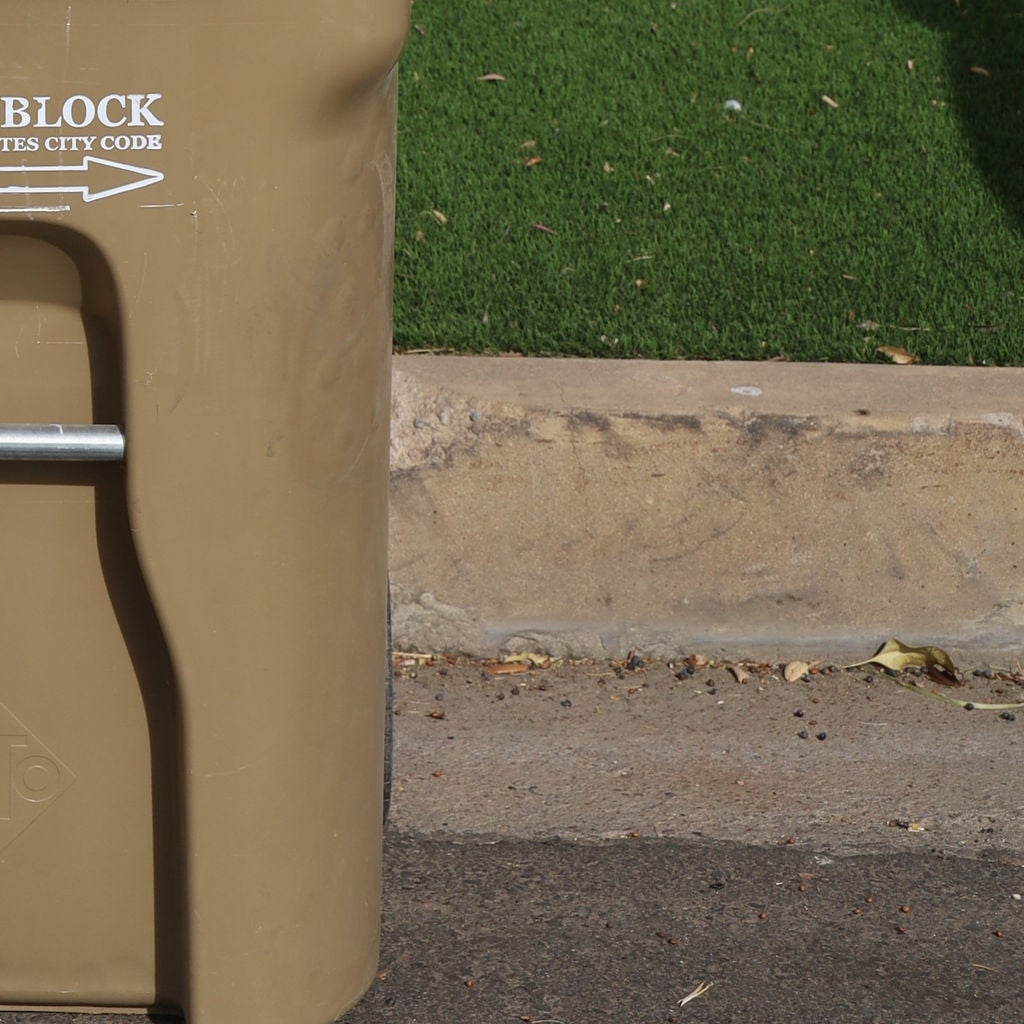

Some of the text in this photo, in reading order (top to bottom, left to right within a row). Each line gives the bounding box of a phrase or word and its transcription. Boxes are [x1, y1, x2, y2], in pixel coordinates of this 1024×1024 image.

[0, 93, 164, 129] BLOCK
[44, 135, 97, 152] CITY
[100, 134, 163, 151] CODE
